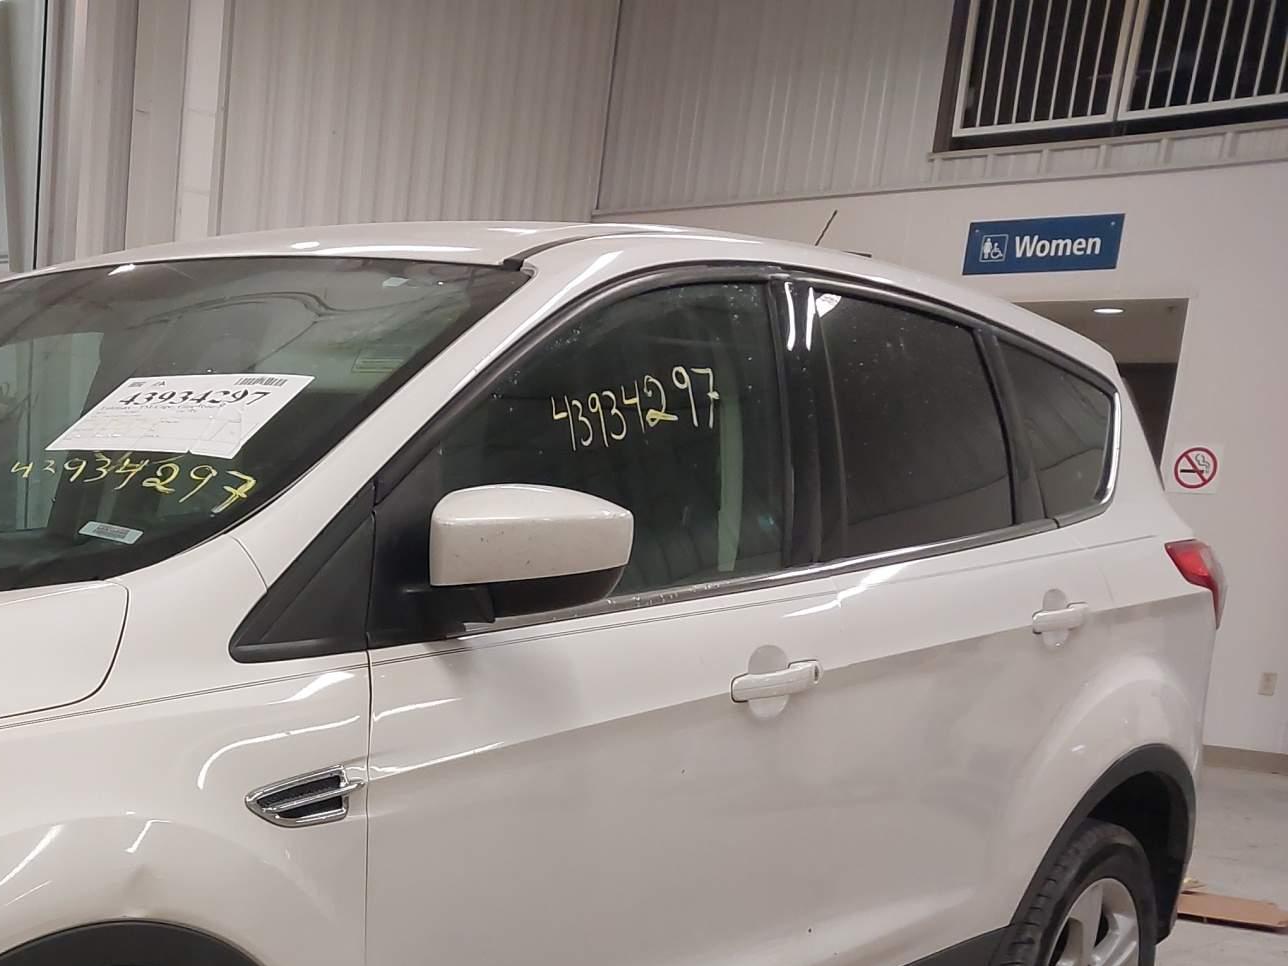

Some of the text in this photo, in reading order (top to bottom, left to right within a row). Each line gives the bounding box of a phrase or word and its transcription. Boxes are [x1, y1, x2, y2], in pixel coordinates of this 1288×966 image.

[1015, 234, 1101, 257] Women
[119, 389, 271, 405] 43934297
[551, 366, 719, 450] 43934297
